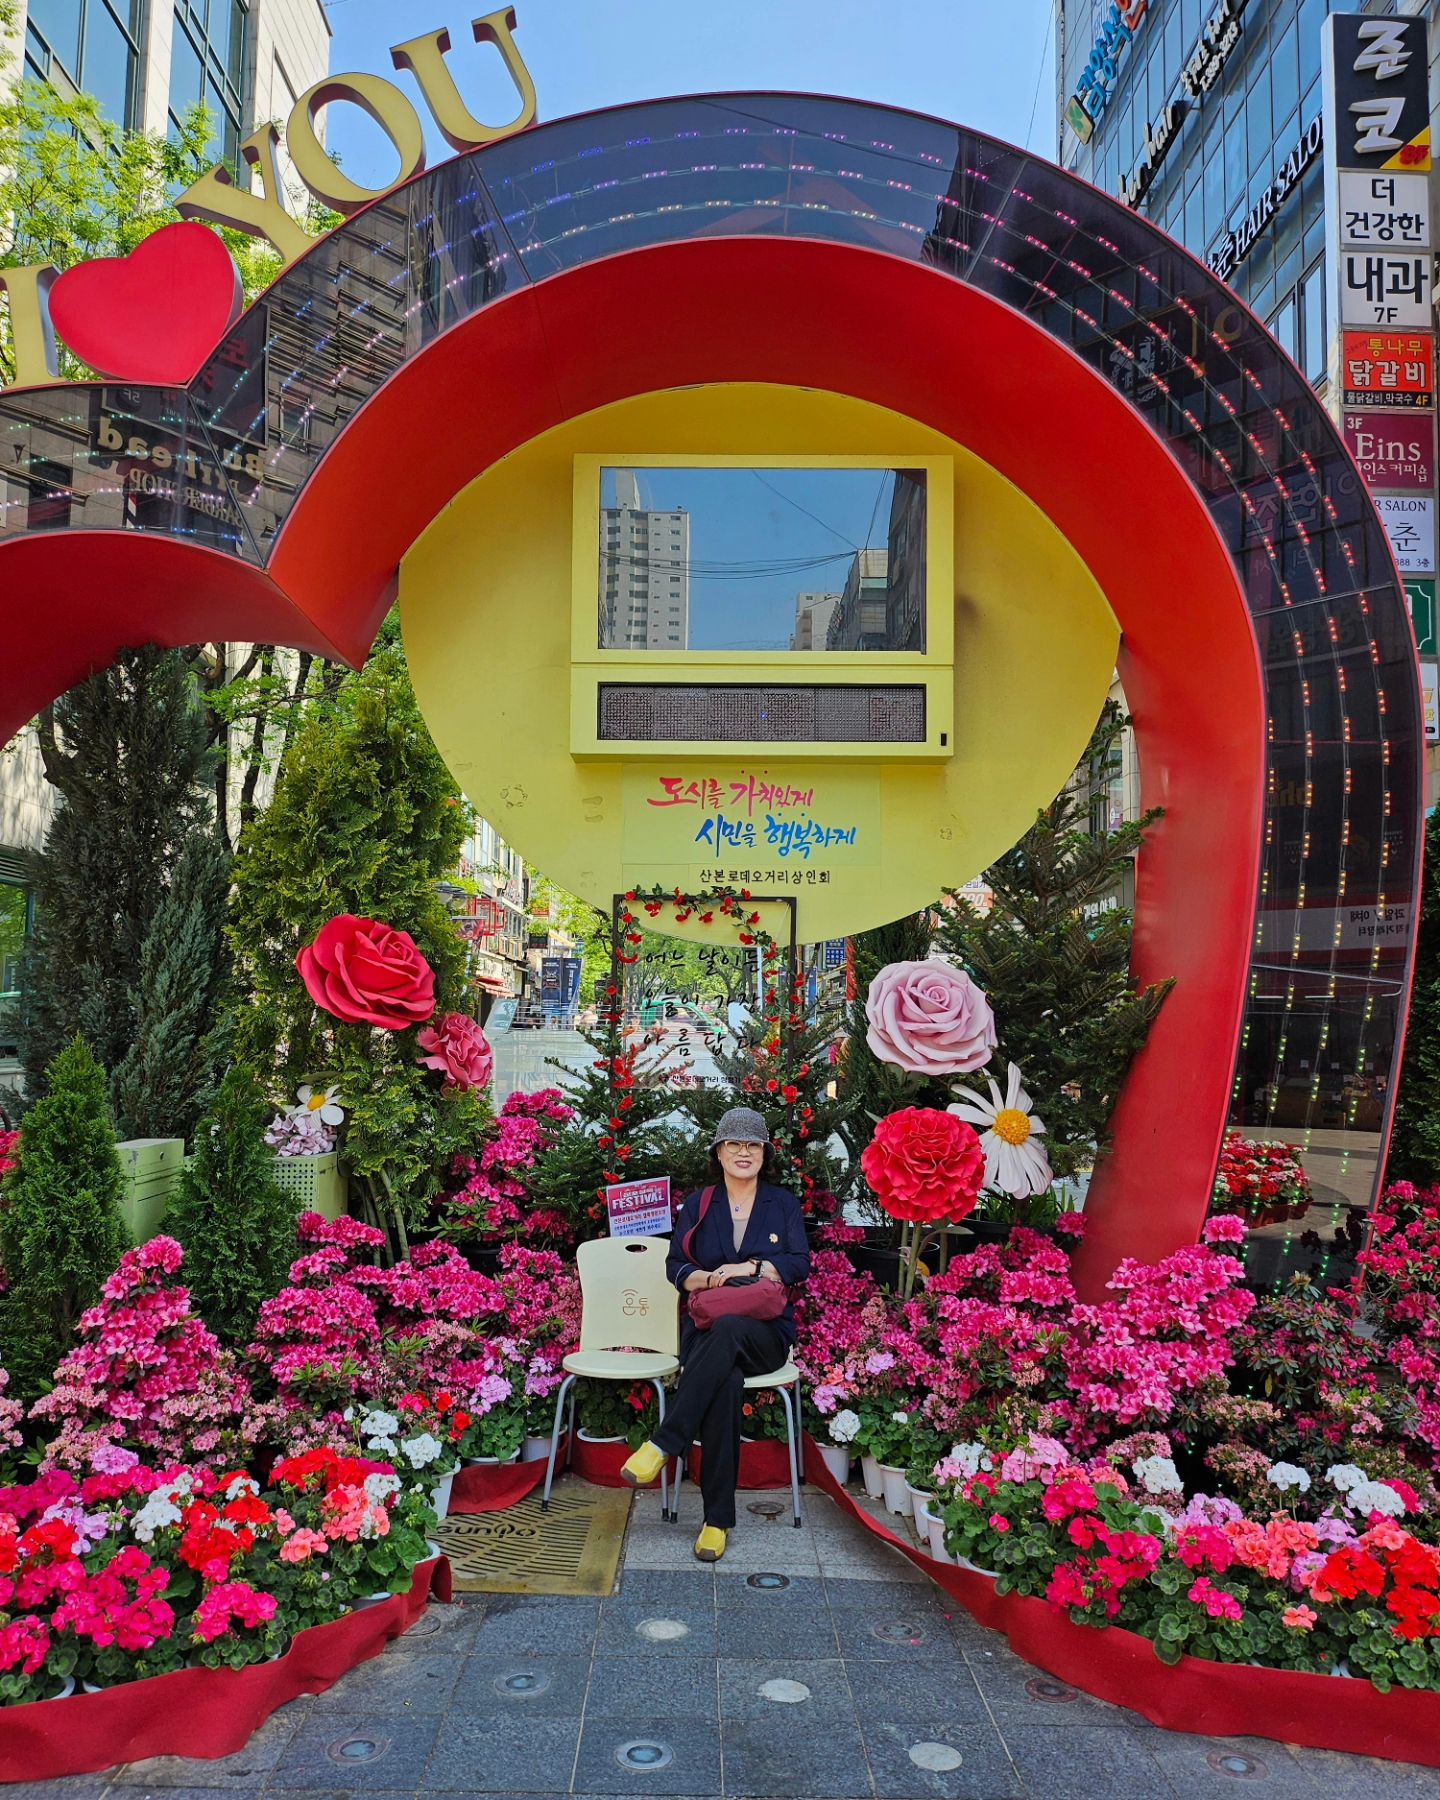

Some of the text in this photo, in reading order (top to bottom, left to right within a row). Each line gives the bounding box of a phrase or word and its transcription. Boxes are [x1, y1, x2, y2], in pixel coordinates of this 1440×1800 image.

[1348, 20, 1413, 154] 준코
[173, 5, 538, 271] YOU
[1235, 186, 1274, 263] HAIR
[1276, 113, 1323, 202] SALO
[1371, 178, 1395, 207] 더
[1345, 211, 1425, 241] 건강한
[1347, 256, 1429, 304] 내과
[1374, 307, 1399, 323] 7F
[1367, 338, 1424, 357] 통나무
[1348, 360, 1426, 388] 닭갈비
[1415, 395, 1429, 407] 4F
[1347, 417, 1363, 430] 3F
[1355, 433, 1421, 462] Eins
[1385, 501, 1426, 512] SALON
[647, 772, 814, 817] 도시를 가치있게
[694, 812, 857, 859] 시민을 행복하게
[645, 950, 686, 968] 어느
[644, 987, 761, 1018] 오늘이 가장
[611, 1191, 665, 1210] FESTIVAL
